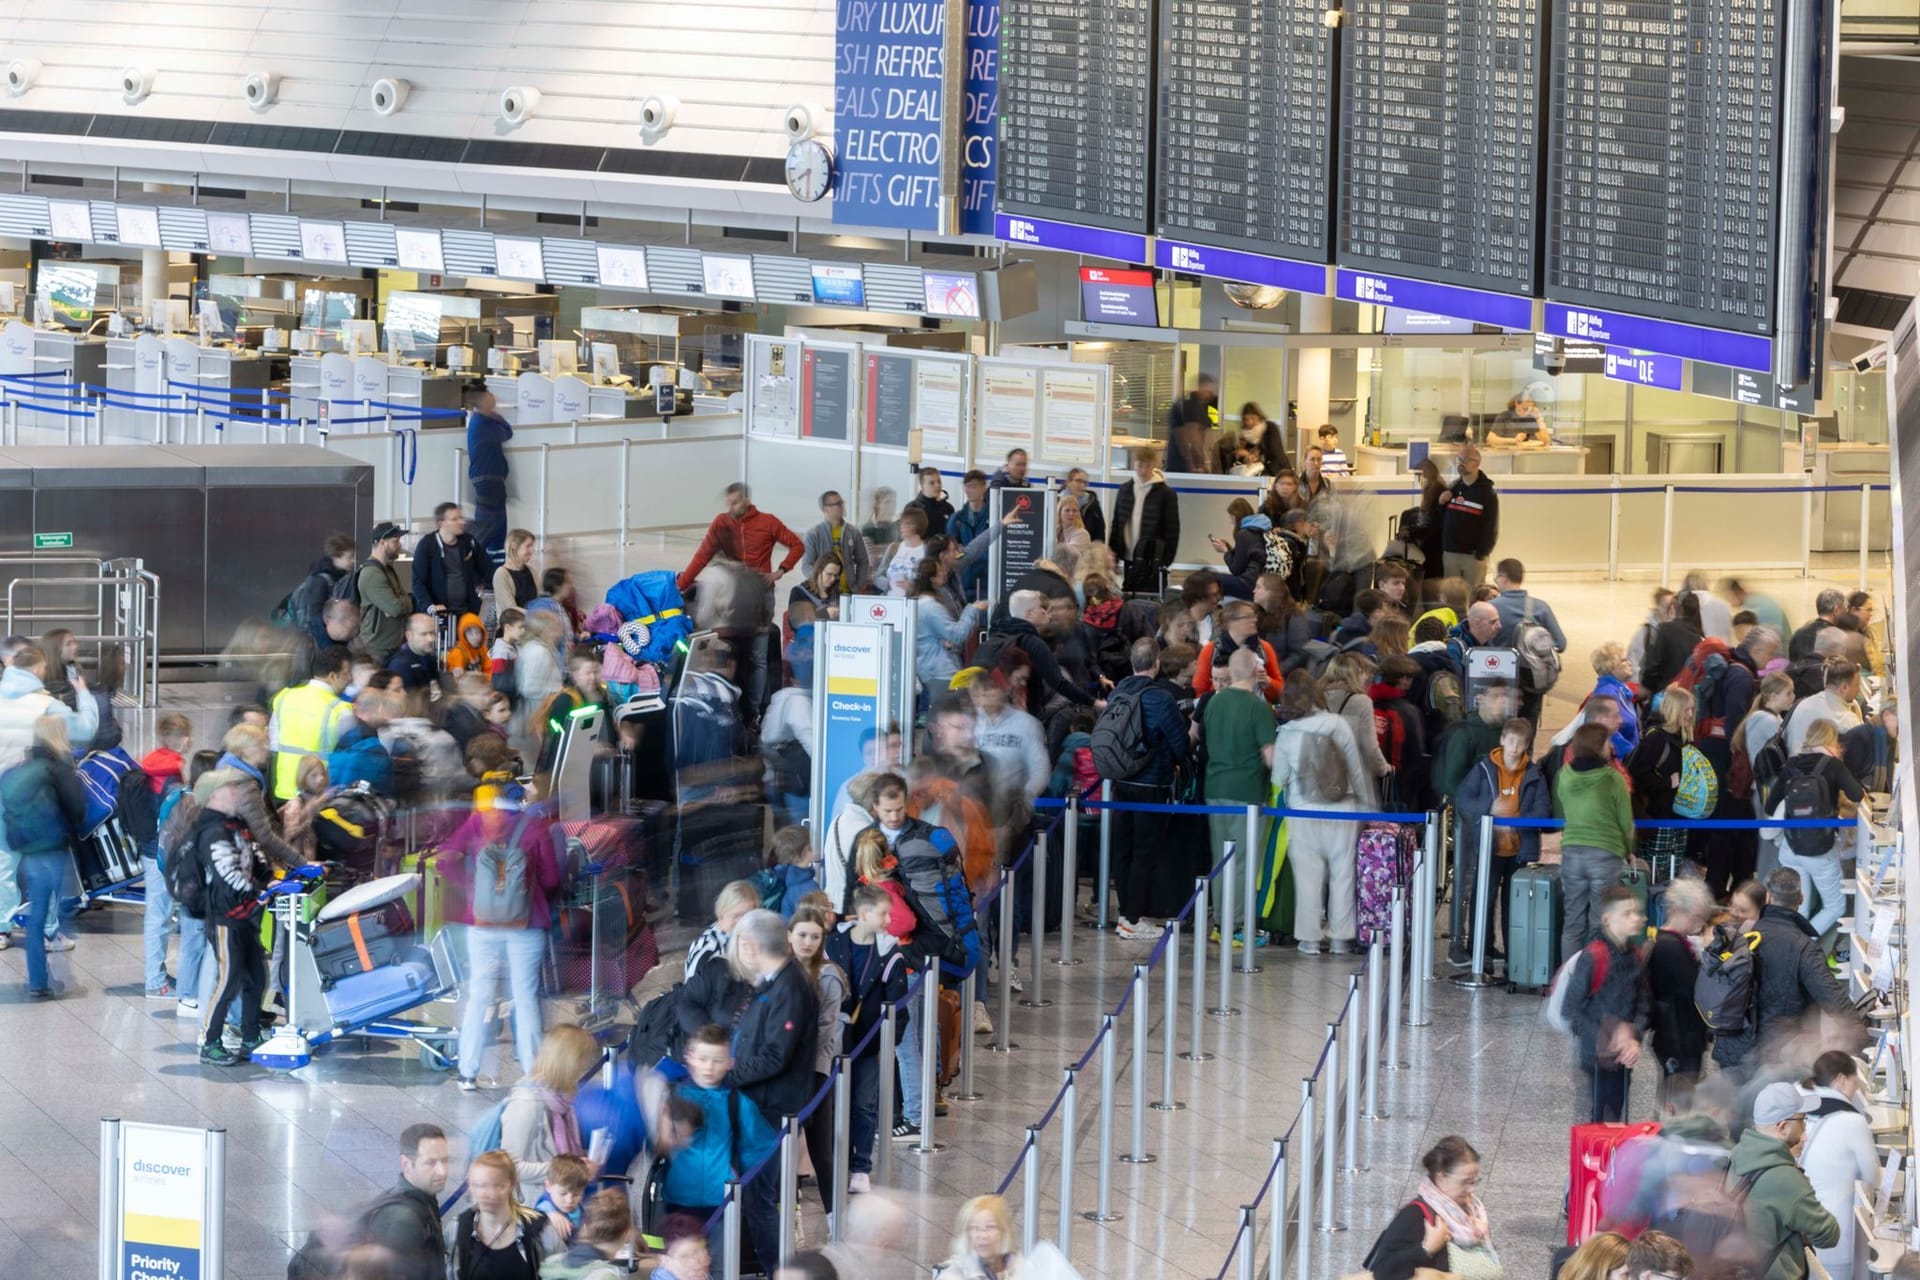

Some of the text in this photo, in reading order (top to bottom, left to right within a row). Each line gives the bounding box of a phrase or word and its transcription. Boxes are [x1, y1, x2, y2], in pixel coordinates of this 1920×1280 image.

[837, 1, 877, 32] URY
[1599, 110, 1623, 123] SEVILLA
[1645, 287, 1662, 300] TESLA
[833, 643, 871, 653] discover
[832, 701, 872, 711] Check-in
[133, 1160, 191, 1176] discover
[131, 1254, 180, 1274] Priority
